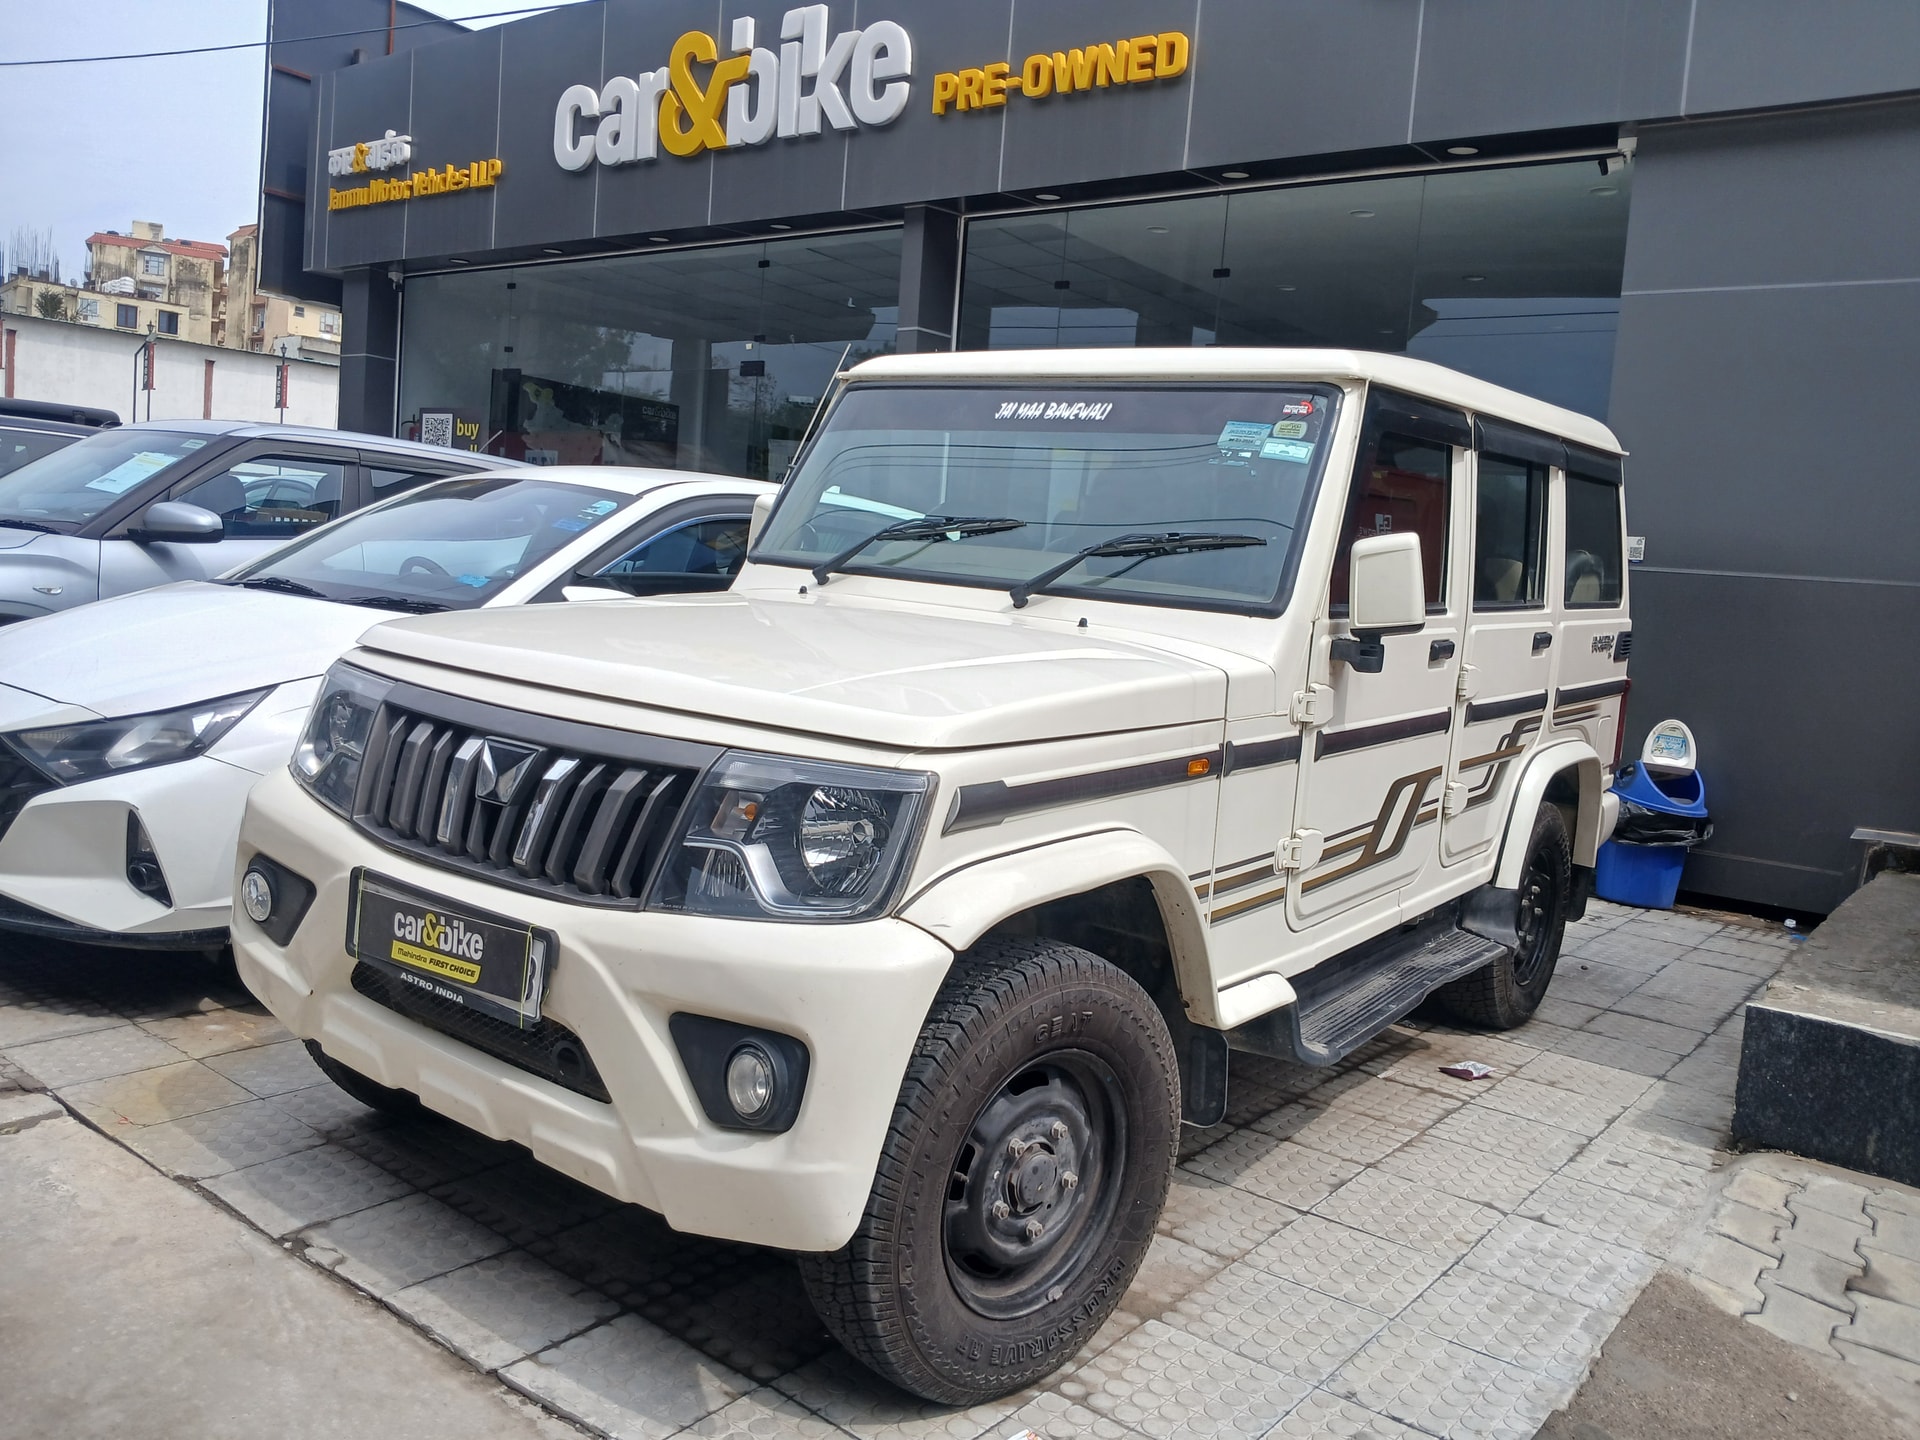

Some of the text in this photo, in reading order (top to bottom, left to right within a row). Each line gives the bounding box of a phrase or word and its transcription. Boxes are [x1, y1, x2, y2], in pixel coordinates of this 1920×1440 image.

[553, 4, 1190, 171] car&bike PRE-OWNED
[328, 158, 502, 211] Jammu Motor Vehicles LLP
[995, 402, 1113, 421] JAI MAA BAWEWALI
[456, 418, 480, 440] buy
[394, 912, 484, 960] car&bike
[397, 947, 477, 978] Mahindra FIRST CHOICE
[400, 972, 464, 1004] ASTRO INDIA
